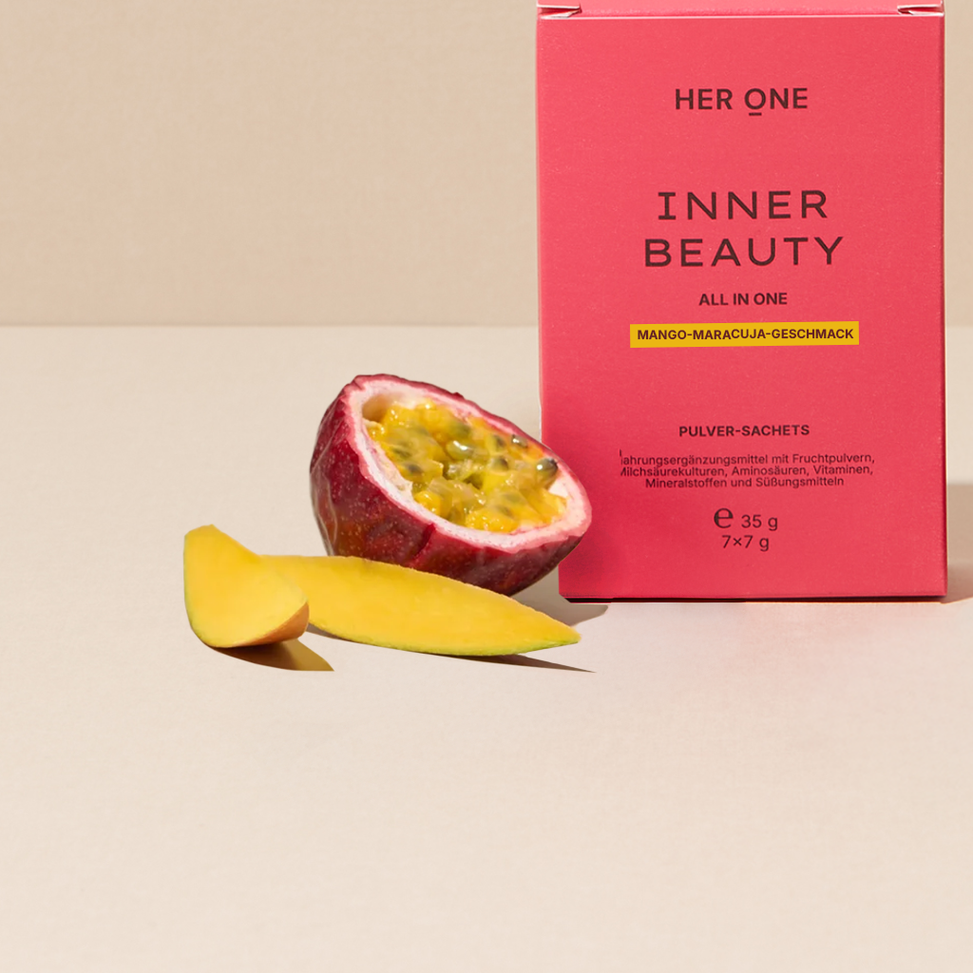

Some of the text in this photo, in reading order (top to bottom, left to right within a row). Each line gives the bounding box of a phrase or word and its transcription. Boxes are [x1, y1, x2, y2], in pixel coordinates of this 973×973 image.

[675, 87, 808, 117] HER ONE
[657, 189, 828, 221] INNER
[644, 236, 844, 267] BEAUTY
[698, 292, 788, 306] ALL IN ONE
[637, 328, 854, 340] MANGO-MARACUJA-GESCHMACK
[679, 424, 810, 437] PULVER-SACHETS
[771, 453, 789, 464] mit
[792, 453, 875, 467] Fruchtpulvern,
[731, 465, 810, 478] Aminosäuren,
[813, 464, 873, 477] Vitaminen,
[645, 476, 844, 489] Mineralstoffen und Süßungsmitteln
[741, 514, 762, 529] 35
[767, 516, 778, 532] g
[758, 537, 770, 552] g
